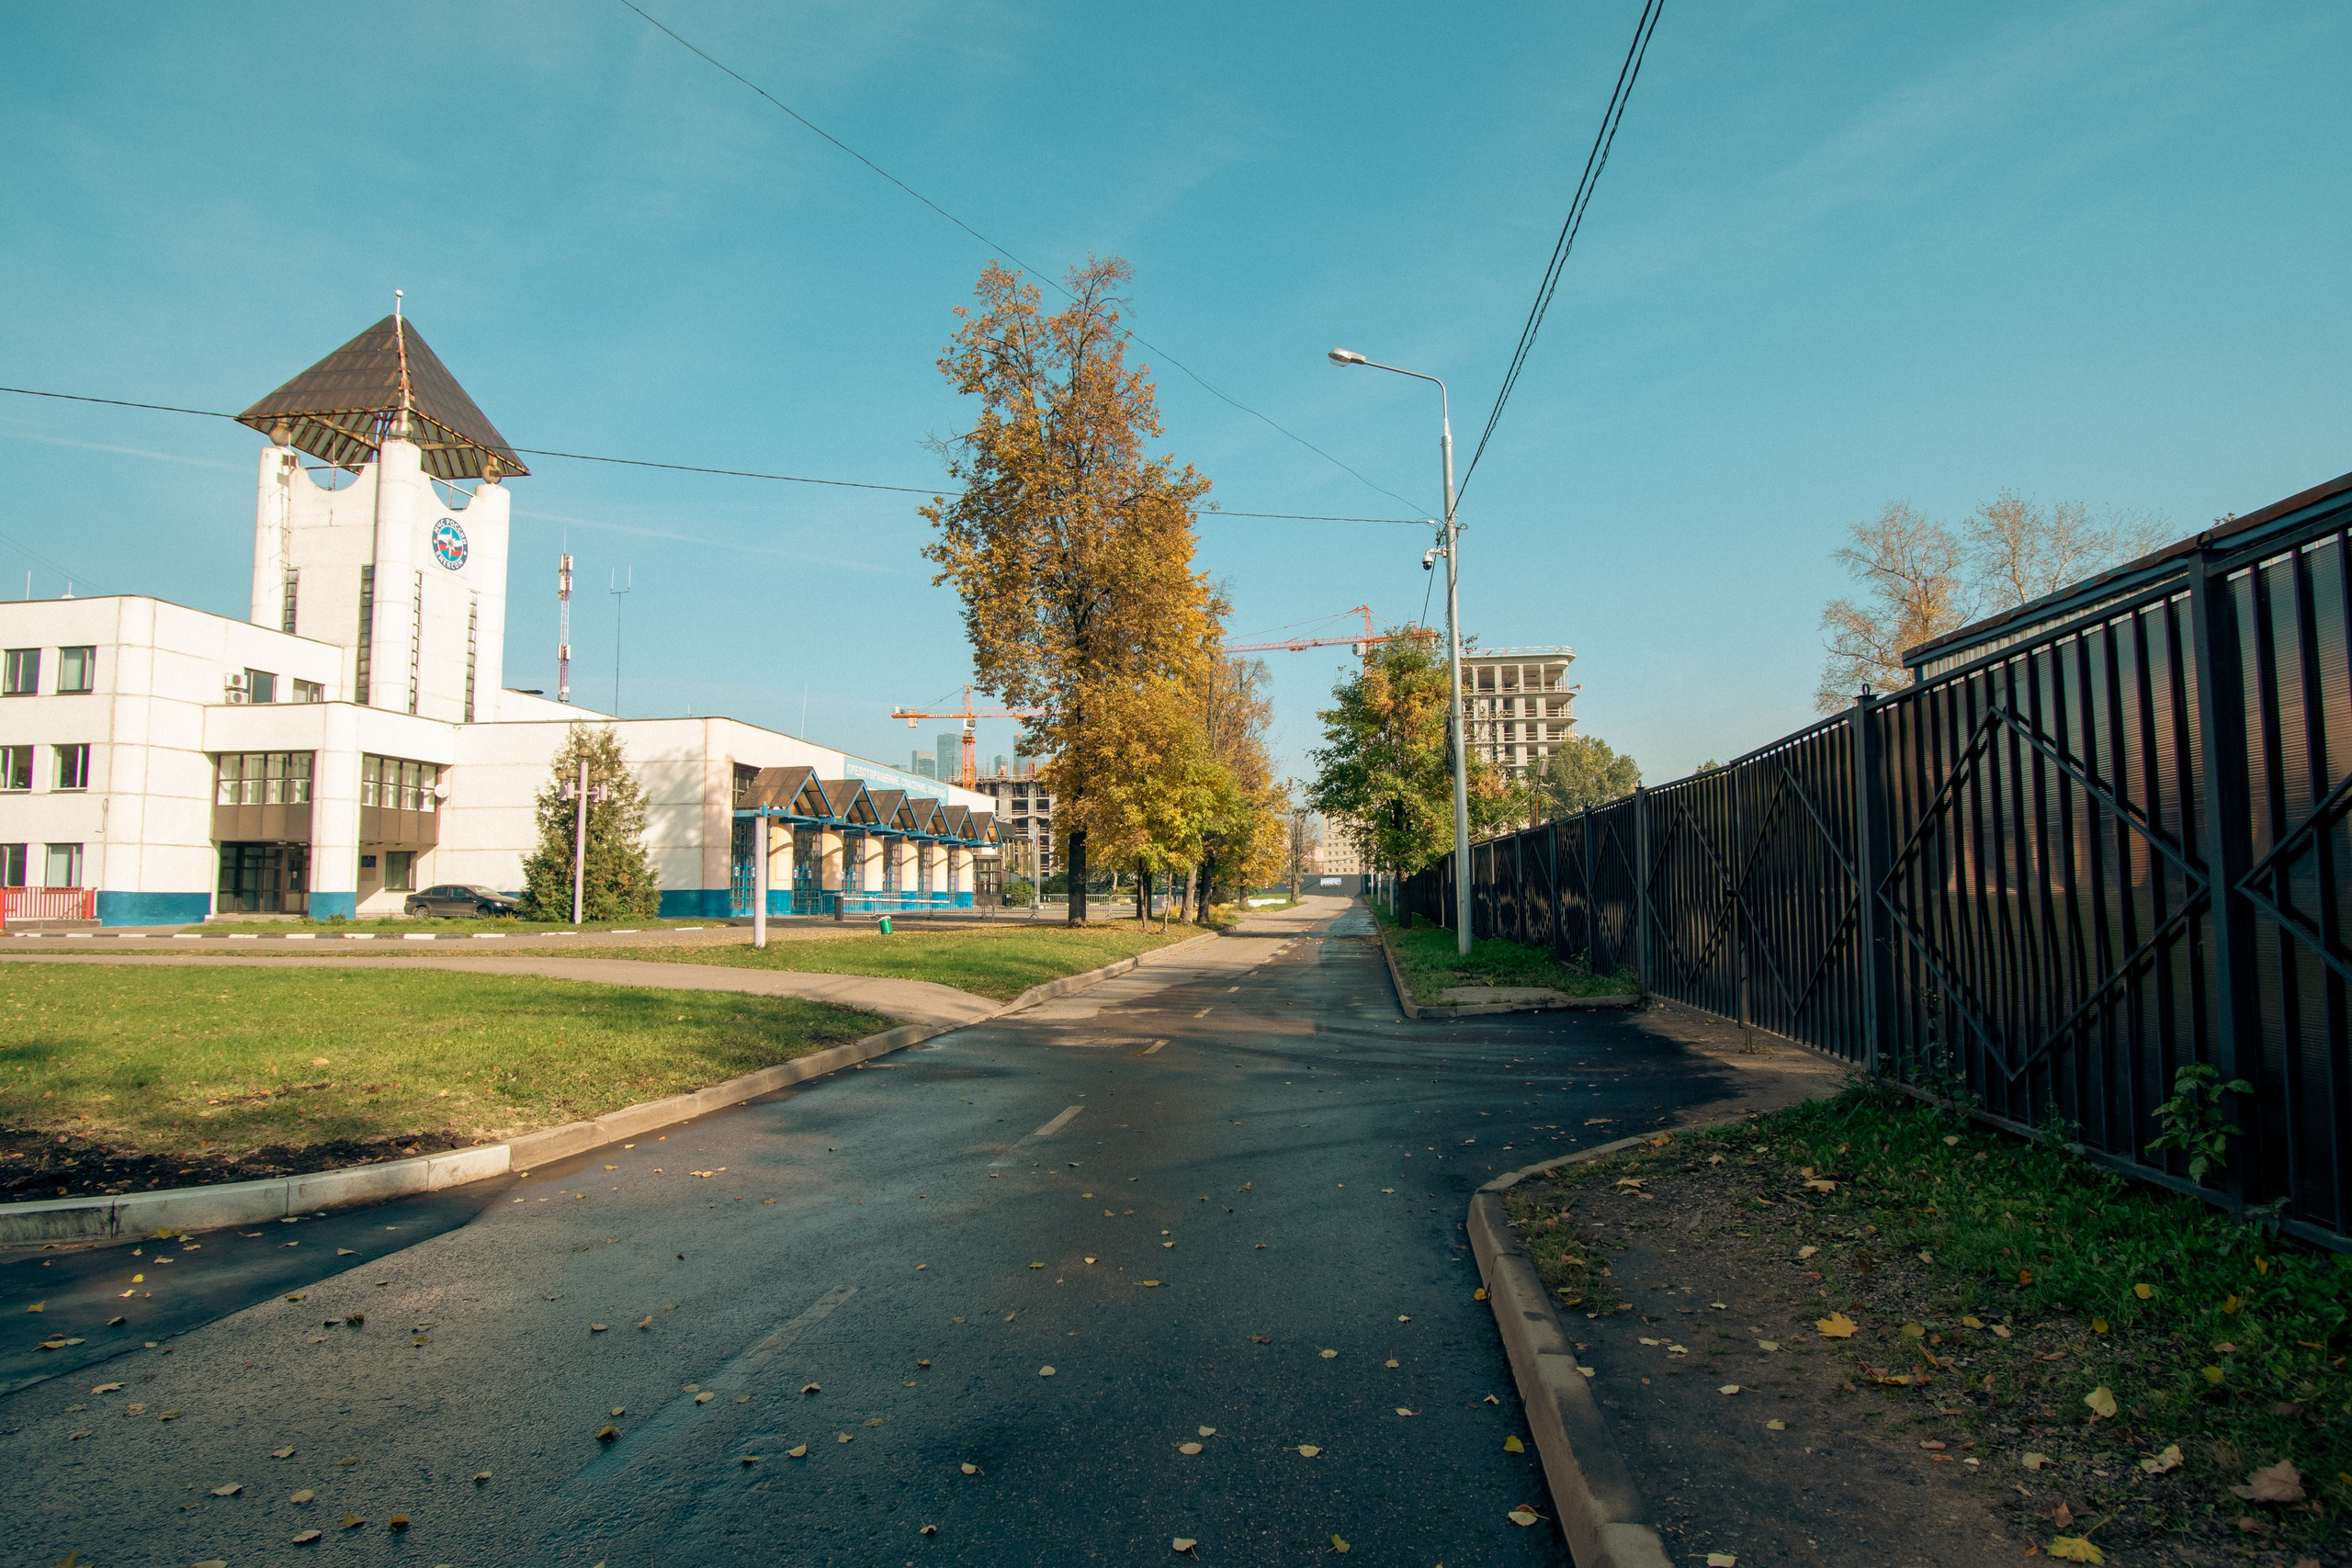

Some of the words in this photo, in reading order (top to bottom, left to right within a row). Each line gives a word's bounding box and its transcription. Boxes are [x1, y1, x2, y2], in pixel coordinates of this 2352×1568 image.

[434, 519, 446, 534] МЧС
[446, 518, 467, 545] РОССИИ
[435, 550, 463, 570] EMERCOM
[847, 763, 900, 787] ПРЕДОТВРАЩЕНИЕ,
